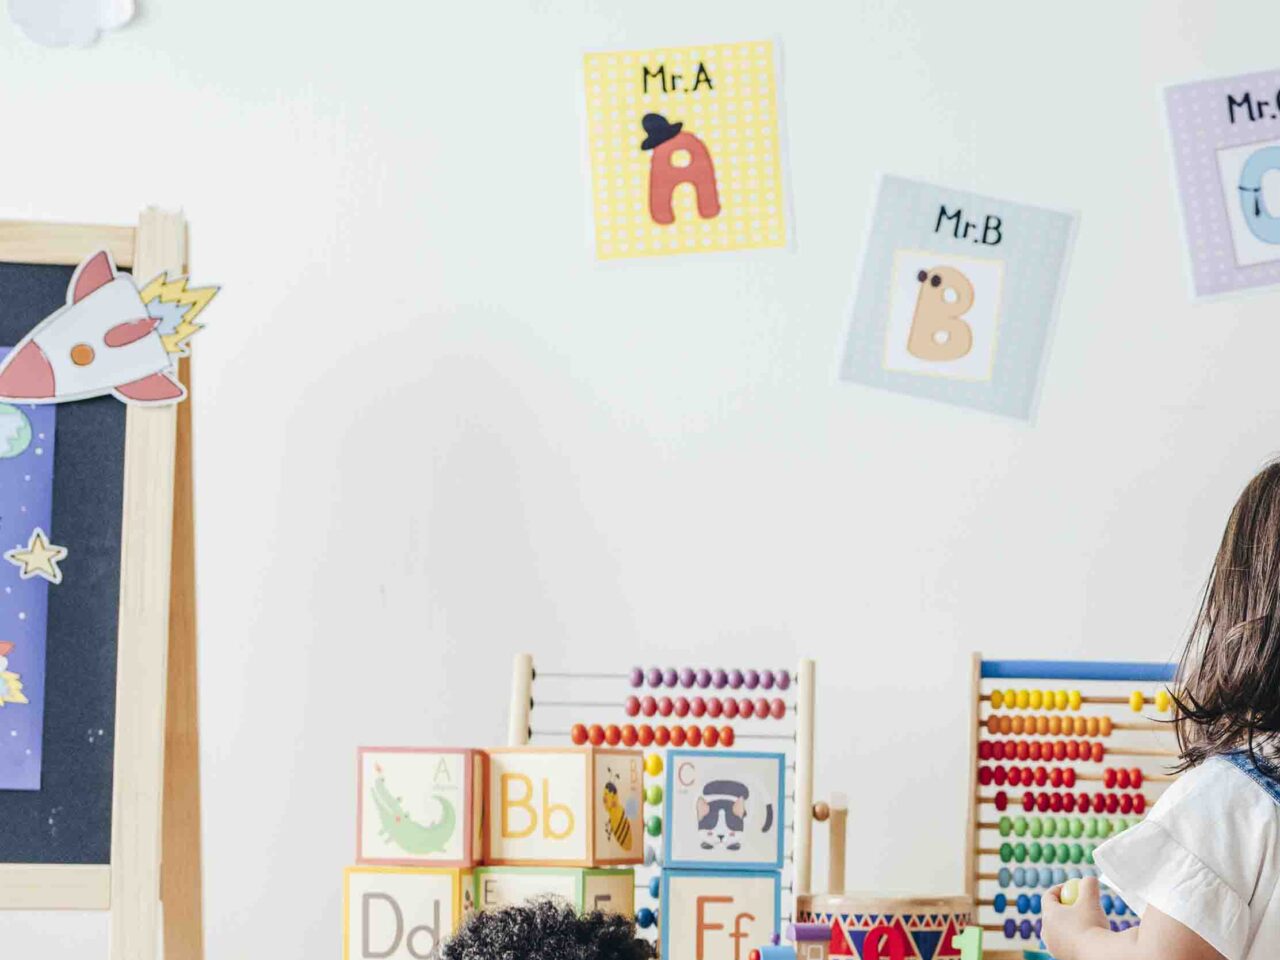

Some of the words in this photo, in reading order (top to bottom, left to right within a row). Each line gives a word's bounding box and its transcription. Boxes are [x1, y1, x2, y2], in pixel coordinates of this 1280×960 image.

[642, 62, 714, 94] Mr.A
[648, 130, 721, 225] A
[935, 206, 1003, 246] Mr.B
[906, 264, 975, 362] B
[678, 762, 696, 787] C
[500, 773, 576, 840] Bb
[484, 879, 498, 904] E
[361, 892, 441, 960] Dd
